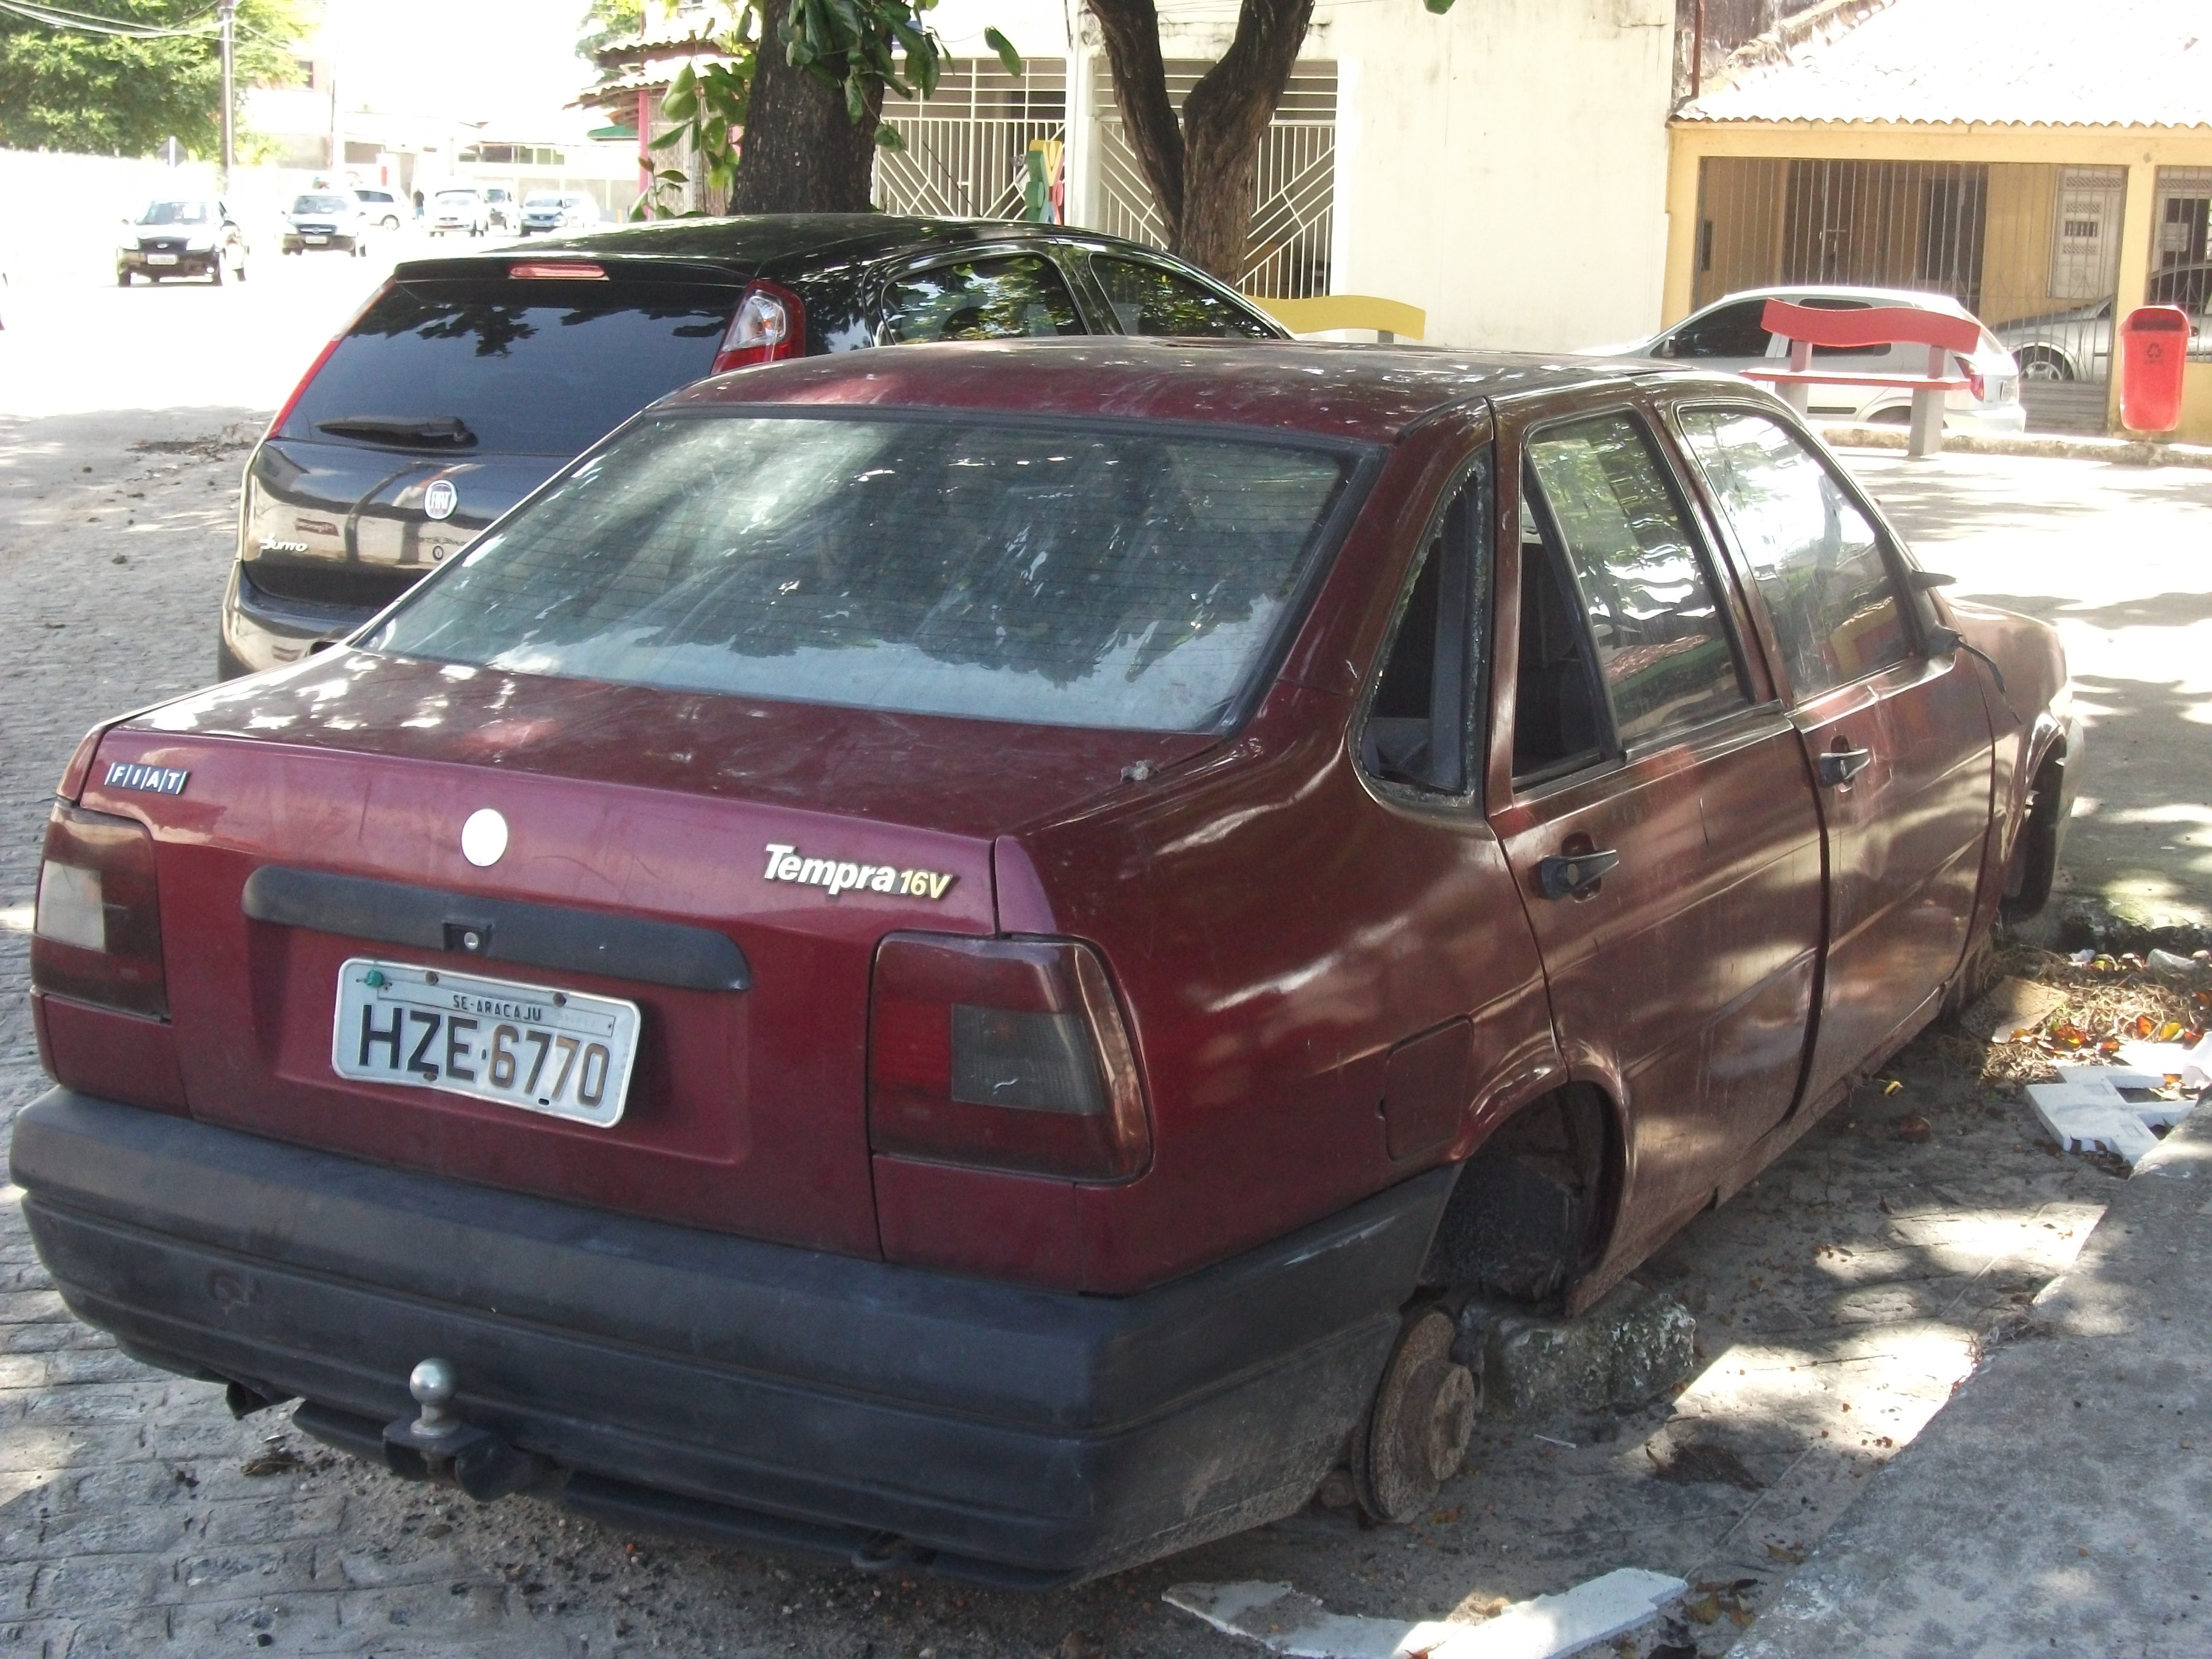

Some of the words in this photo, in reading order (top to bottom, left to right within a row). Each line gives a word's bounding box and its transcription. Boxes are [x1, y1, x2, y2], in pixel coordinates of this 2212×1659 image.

[430, 491, 451, 510] FIAT
[111, 766, 181, 790] FIAT
[764, 843, 896, 895] Tempra
[900, 870, 953, 900] 16V
